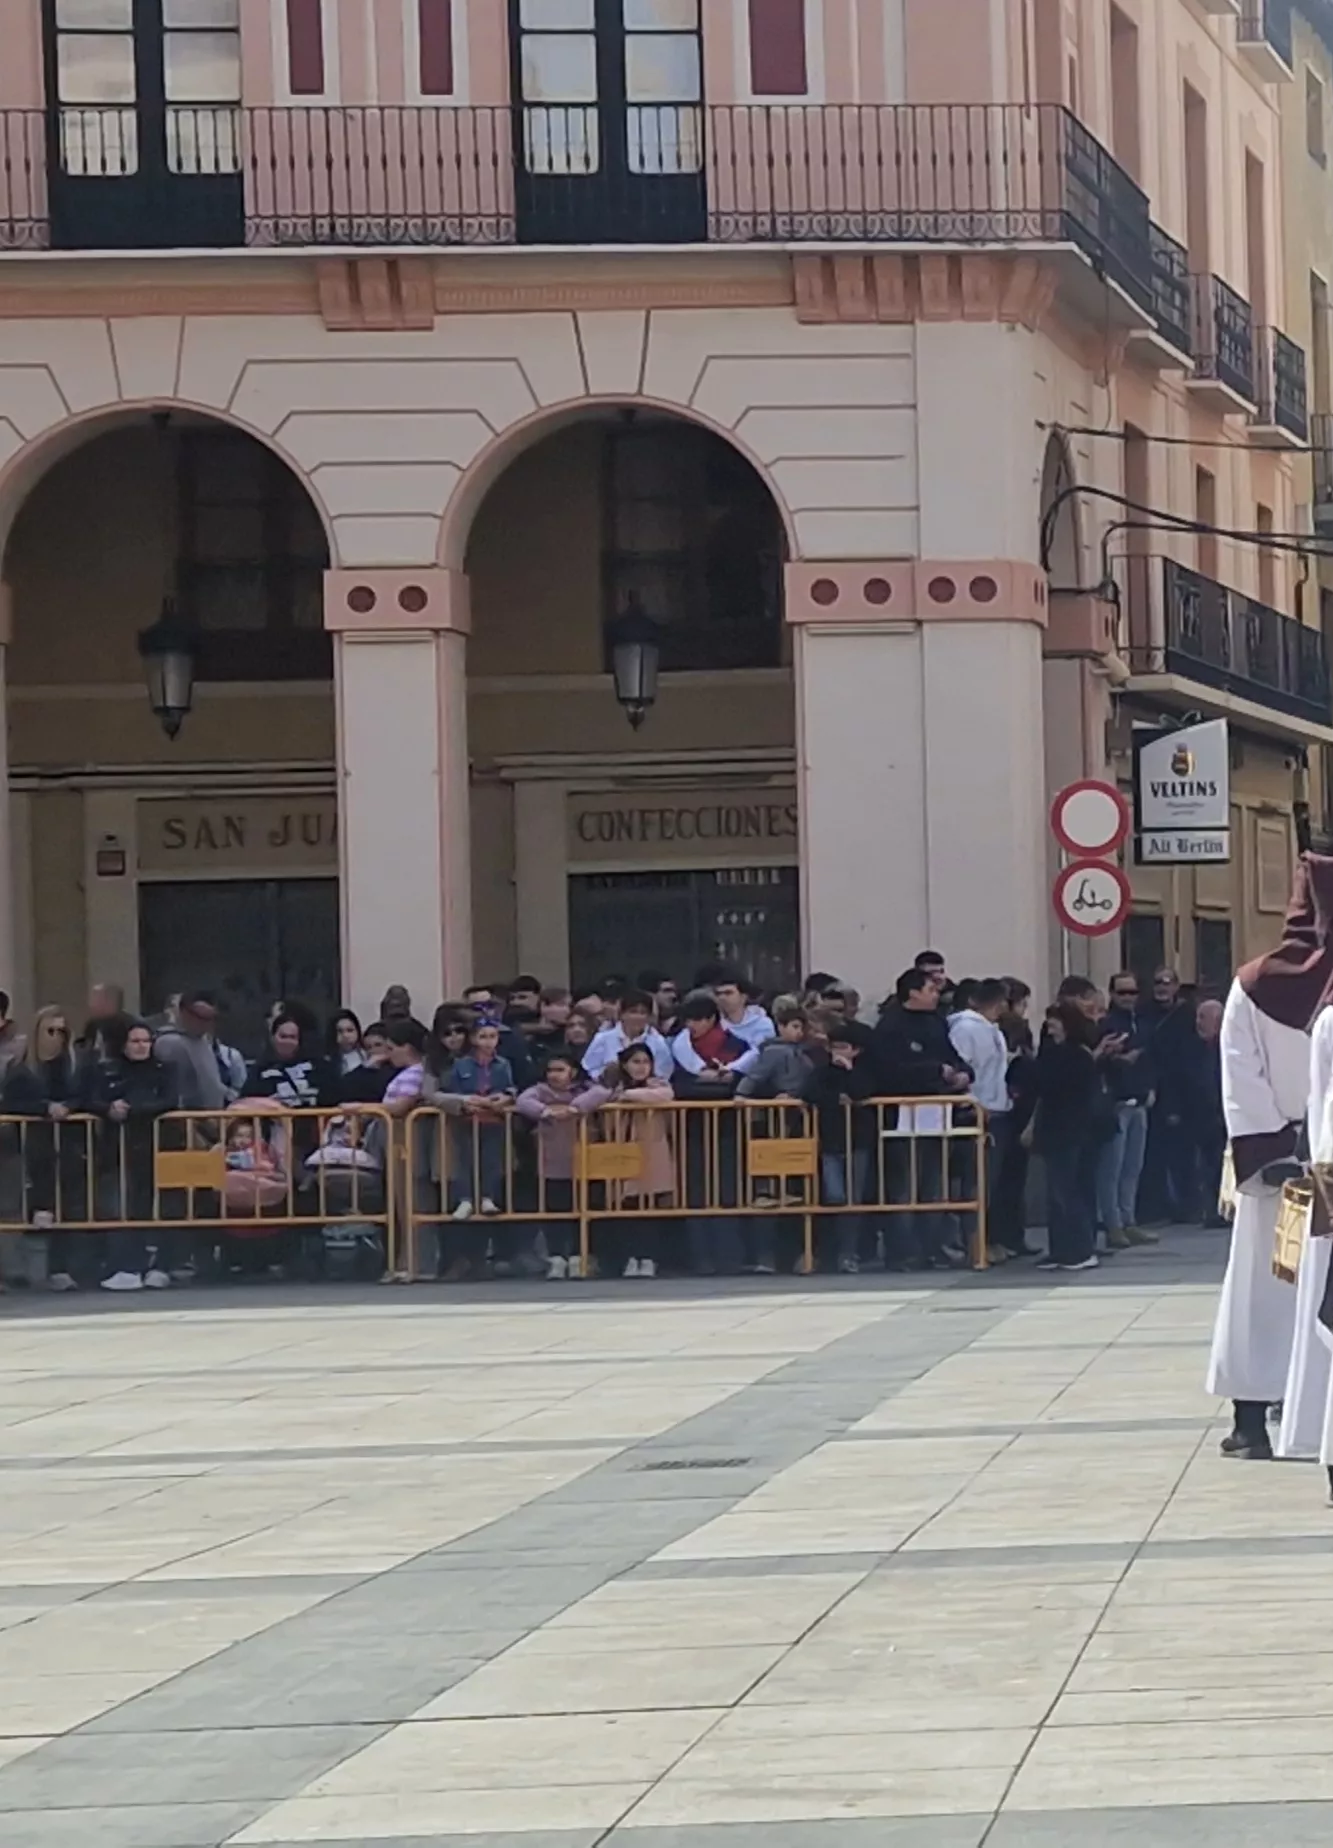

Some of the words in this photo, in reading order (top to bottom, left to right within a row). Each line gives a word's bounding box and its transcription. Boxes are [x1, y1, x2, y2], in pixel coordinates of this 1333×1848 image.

[1150, 781, 1217, 798] VELTINS
[162, 815, 245, 849] SAN
[578, 803, 798, 843] CONFECCIONES
[1149, 838, 1171, 855] Alt
[1177, 838, 1224, 854] Berlin
